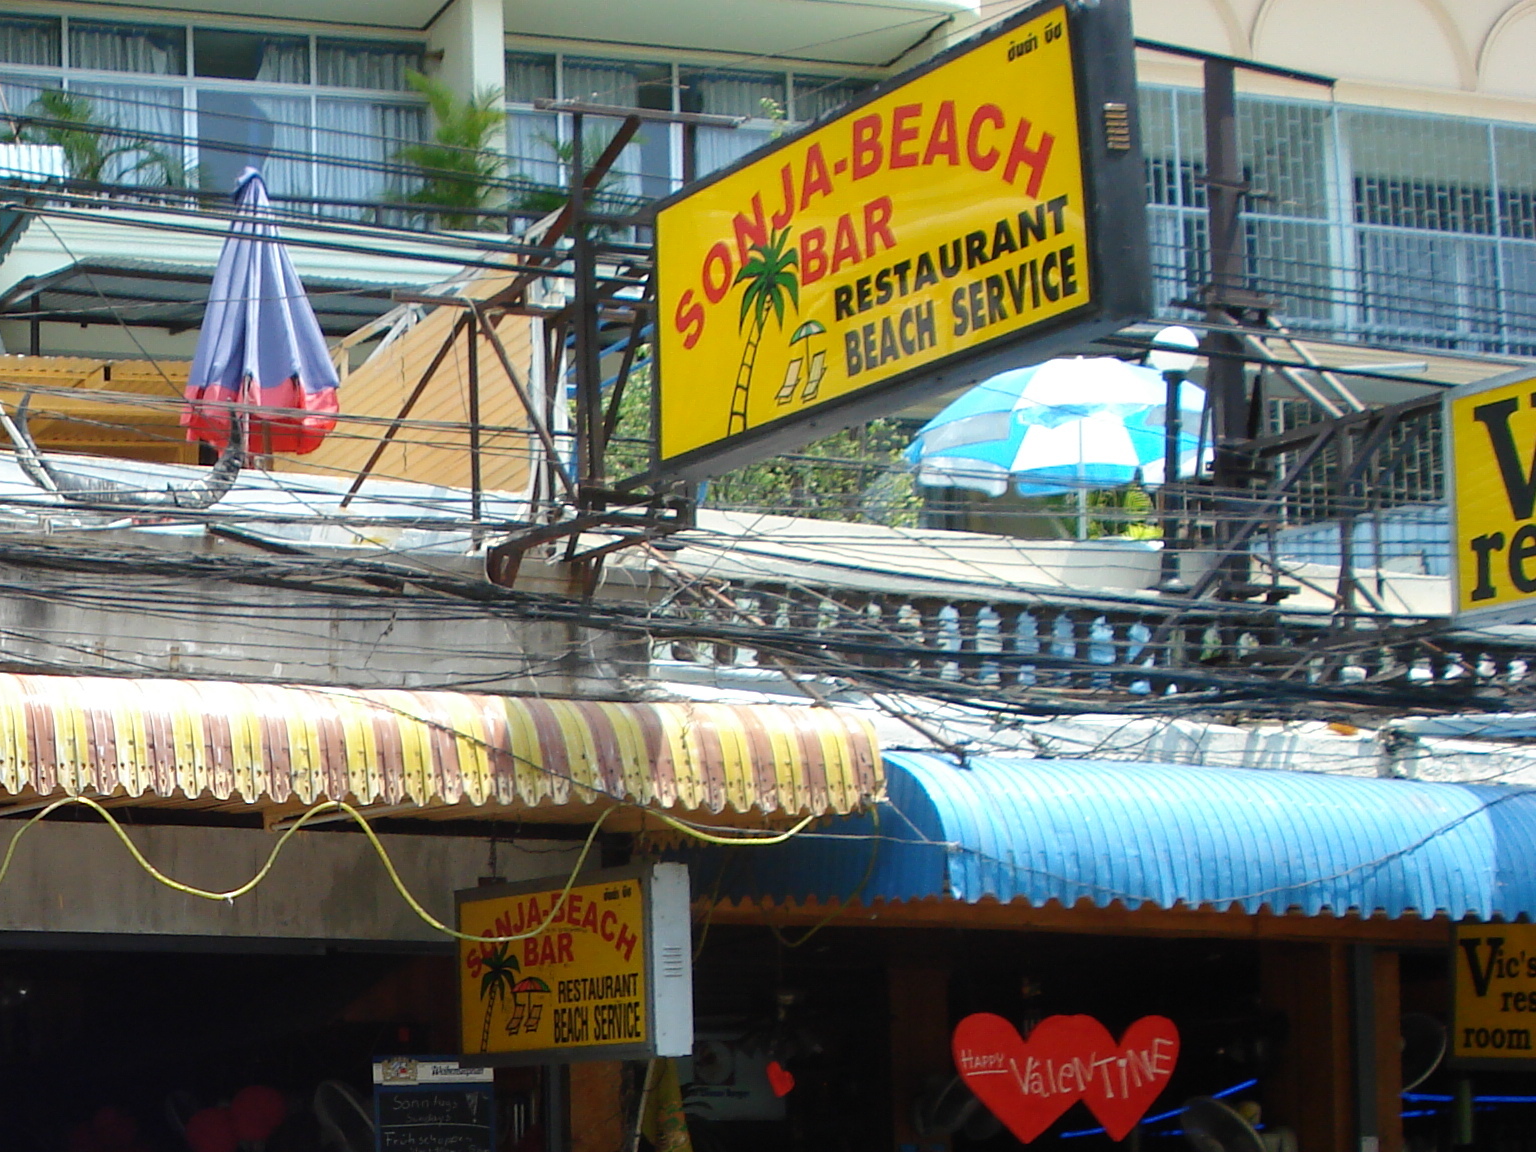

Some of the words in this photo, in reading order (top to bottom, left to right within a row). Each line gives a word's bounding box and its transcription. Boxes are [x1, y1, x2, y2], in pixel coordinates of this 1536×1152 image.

[675, 100, 1055, 350] SONJA-BEACH
[800, 195, 897, 286] BAR
[834, 194, 1068, 322] RESTAURANT
[845, 300, 937, 378] BEACH
[953, 245, 1078, 337] SERVICE
[467, 893, 637, 978] SONJA-BEACH
[524, 933, 574, 966] BAR
[554, 1005, 588, 1043] BEACH
[594, 1002, 640, 1042] SERVICE
[558, 973, 638, 1003] RESTAURANT
[1463, 1028, 1531, 1050] room
